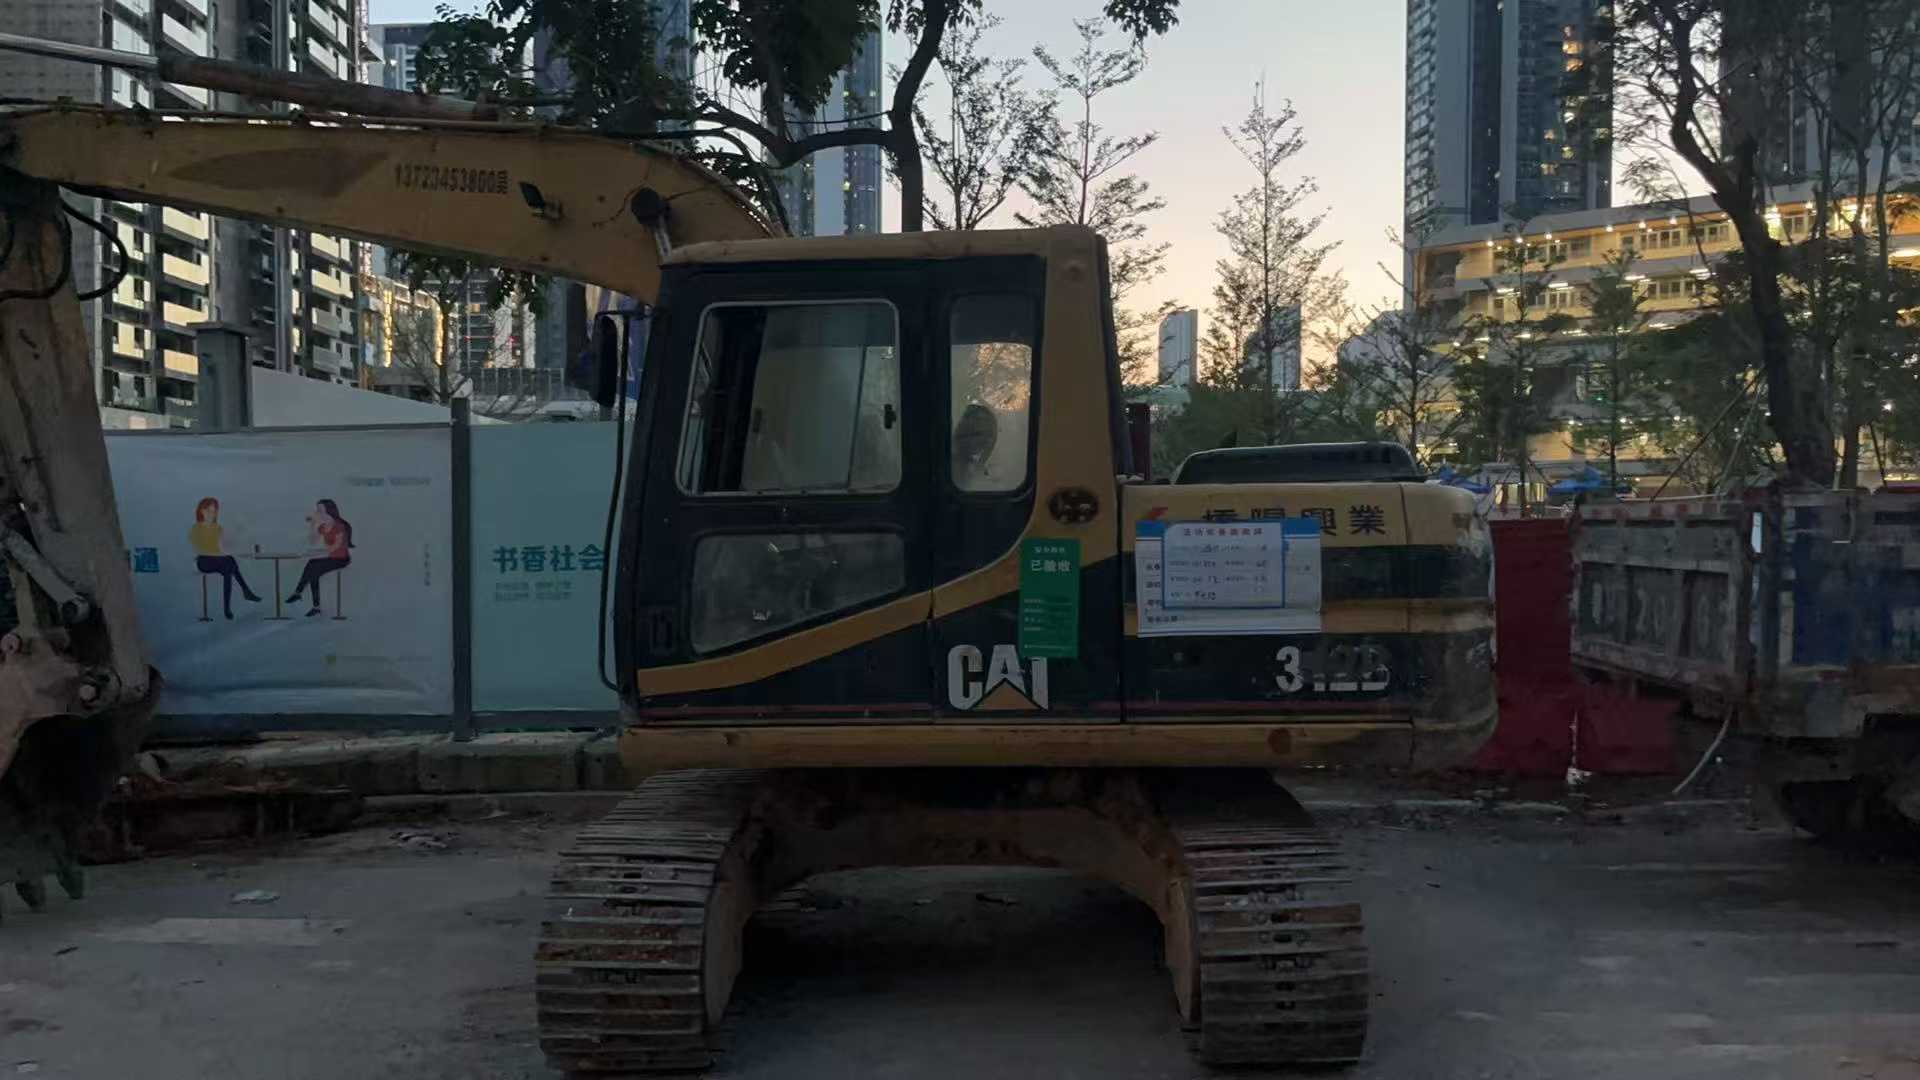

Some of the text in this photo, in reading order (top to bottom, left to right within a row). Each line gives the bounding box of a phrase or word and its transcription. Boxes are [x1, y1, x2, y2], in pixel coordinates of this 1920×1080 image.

[128, 547, 160, 573] 通
[493, 544, 605, 573] 书香社会
